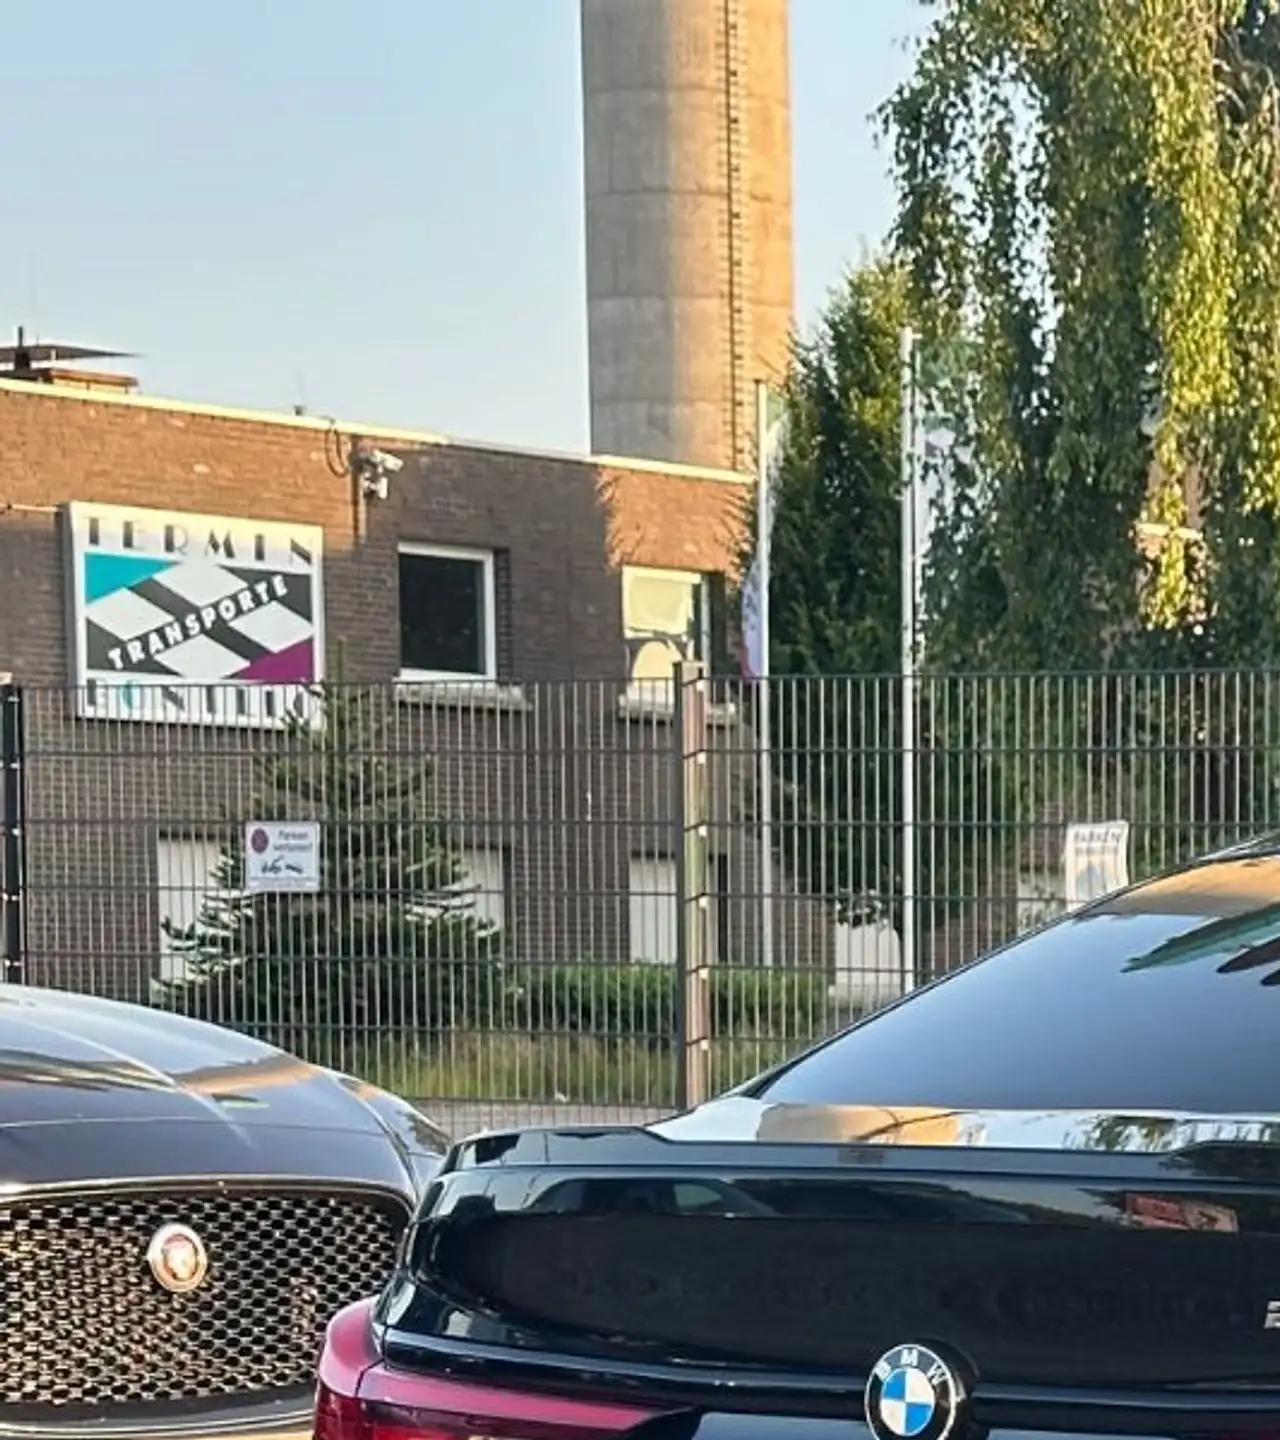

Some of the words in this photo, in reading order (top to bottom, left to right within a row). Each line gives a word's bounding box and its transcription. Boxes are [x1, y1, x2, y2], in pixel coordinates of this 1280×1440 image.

[83, 515, 313, 566] TERMIN
[107, 574, 289, 670] TRANSPORTE
[874, 1349, 951, 1386] BMW
